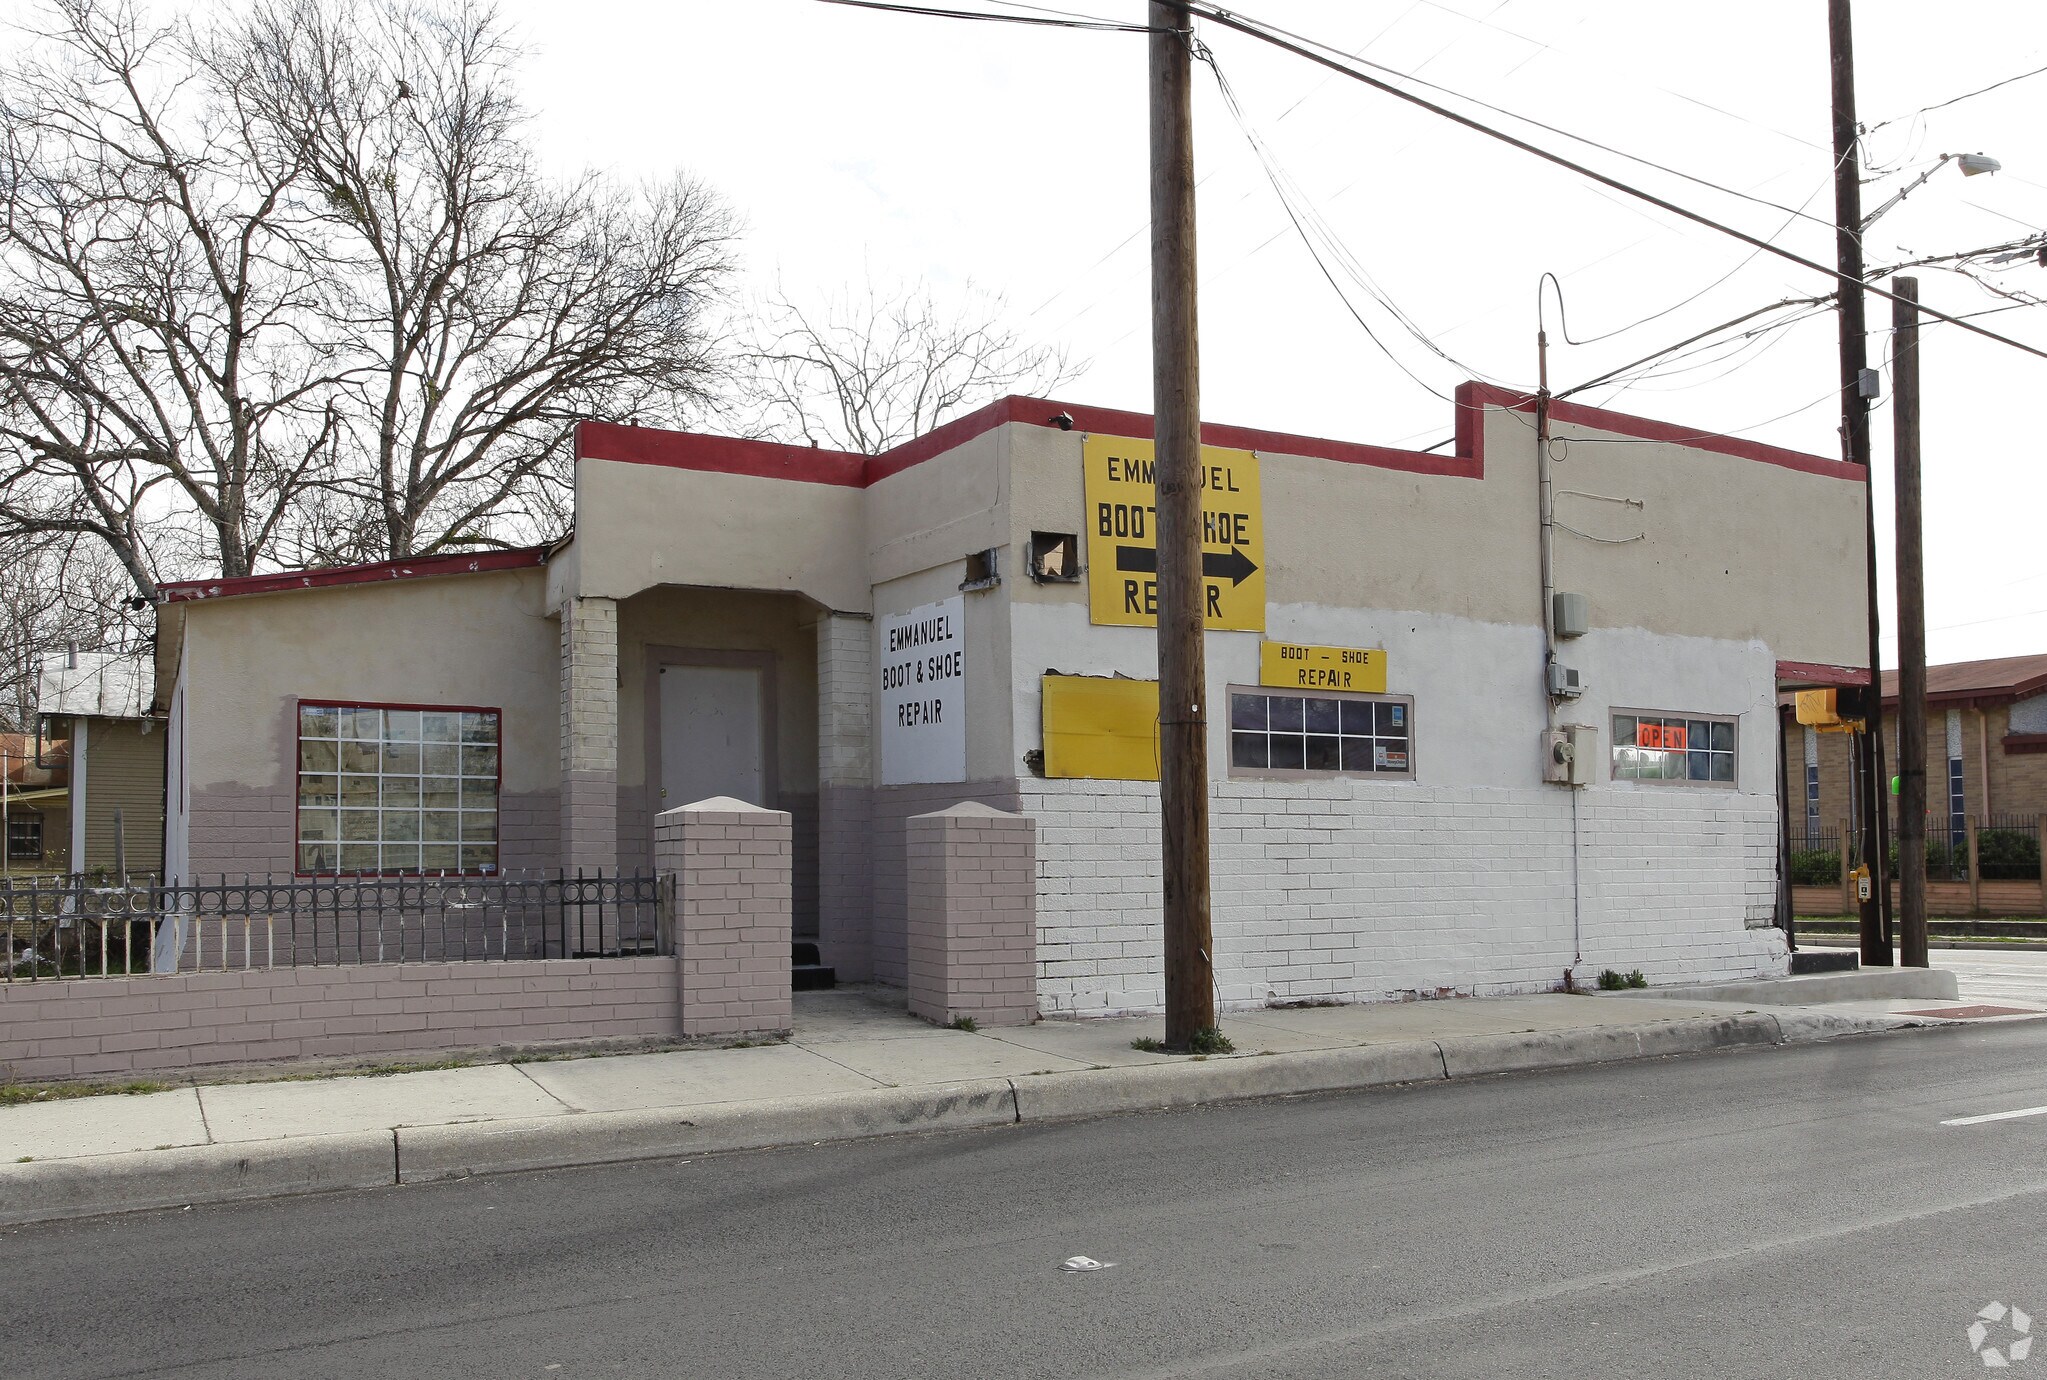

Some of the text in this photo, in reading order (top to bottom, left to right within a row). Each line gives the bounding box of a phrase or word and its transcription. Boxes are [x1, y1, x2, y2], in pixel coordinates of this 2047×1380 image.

[1202, 511, 1250, 545] HOE
[1124, 579, 1223, 618] RER
[890, 615, 953, 652] EMMANUEL
[882, 651, 962, 690] BOOT & SHOE
[1281, 646, 1310, 661] BOOT
[1341, 650, 1369, 665] SHOE
[1298, 668, 1352, 688] REPAIR
[898, 698, 942, 727] REPAIR
[1642, 727, 1682, 749] OPEN
